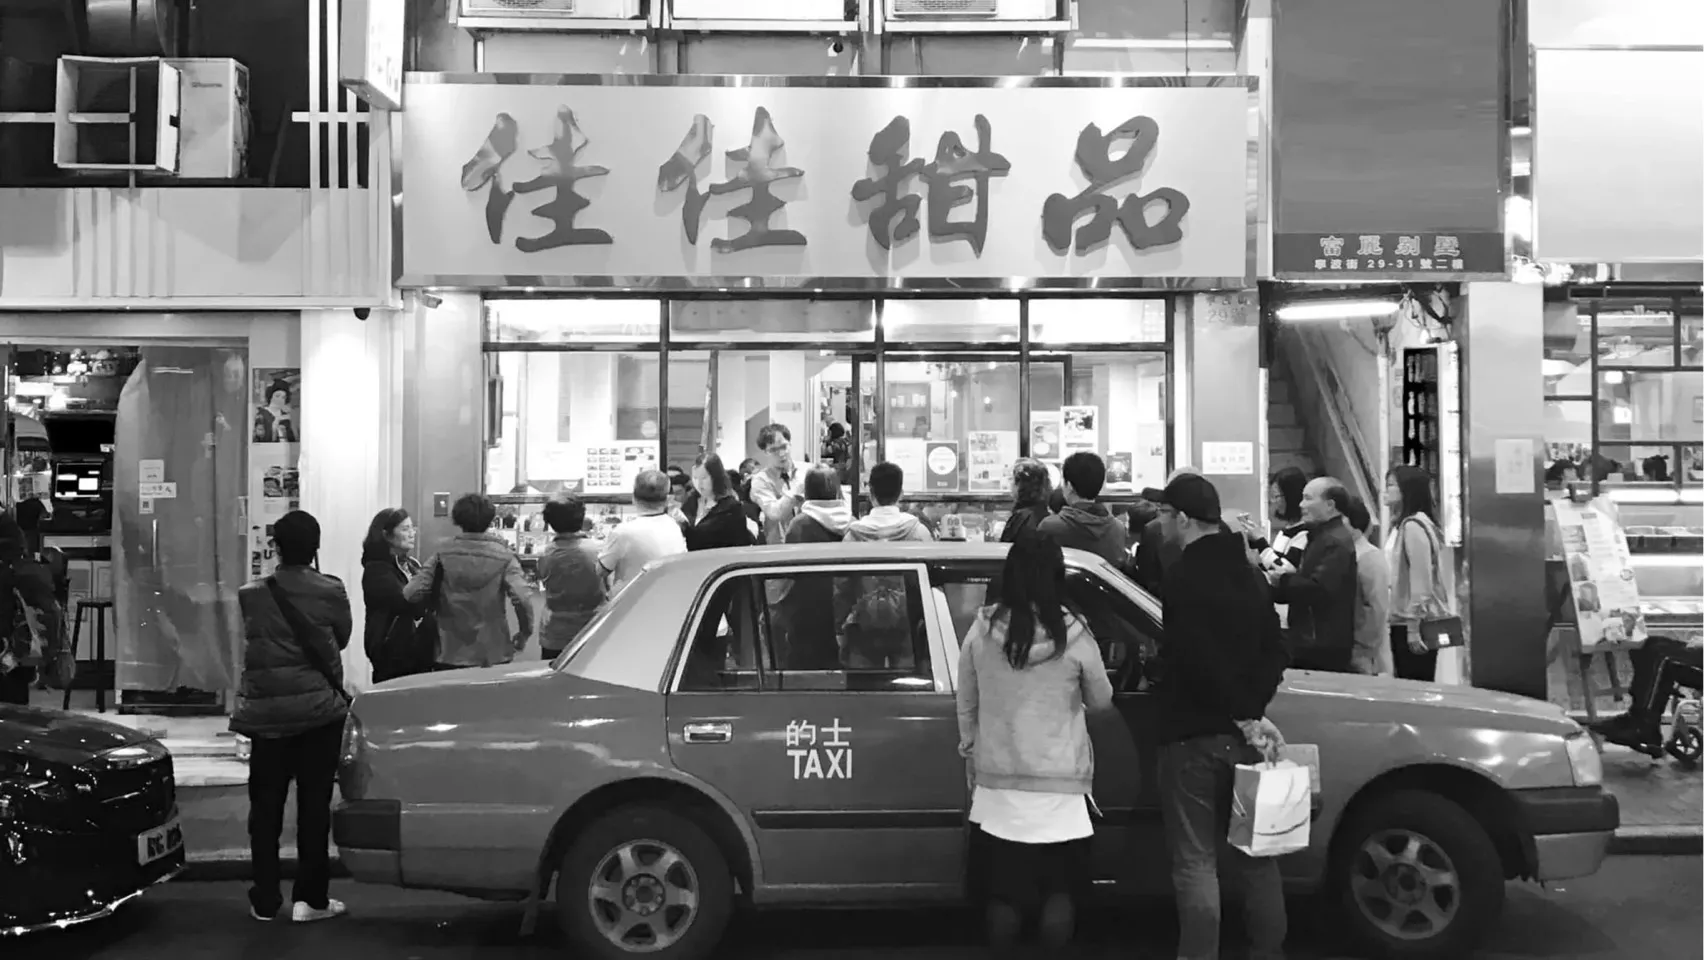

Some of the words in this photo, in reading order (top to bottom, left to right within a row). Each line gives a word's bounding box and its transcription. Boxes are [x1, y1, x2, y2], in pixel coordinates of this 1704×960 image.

[461, 104, 1190, 259] 佳佳甜品
[786, 717, 852, 748] 的士
[786, 748, 853, 780] TAXI
